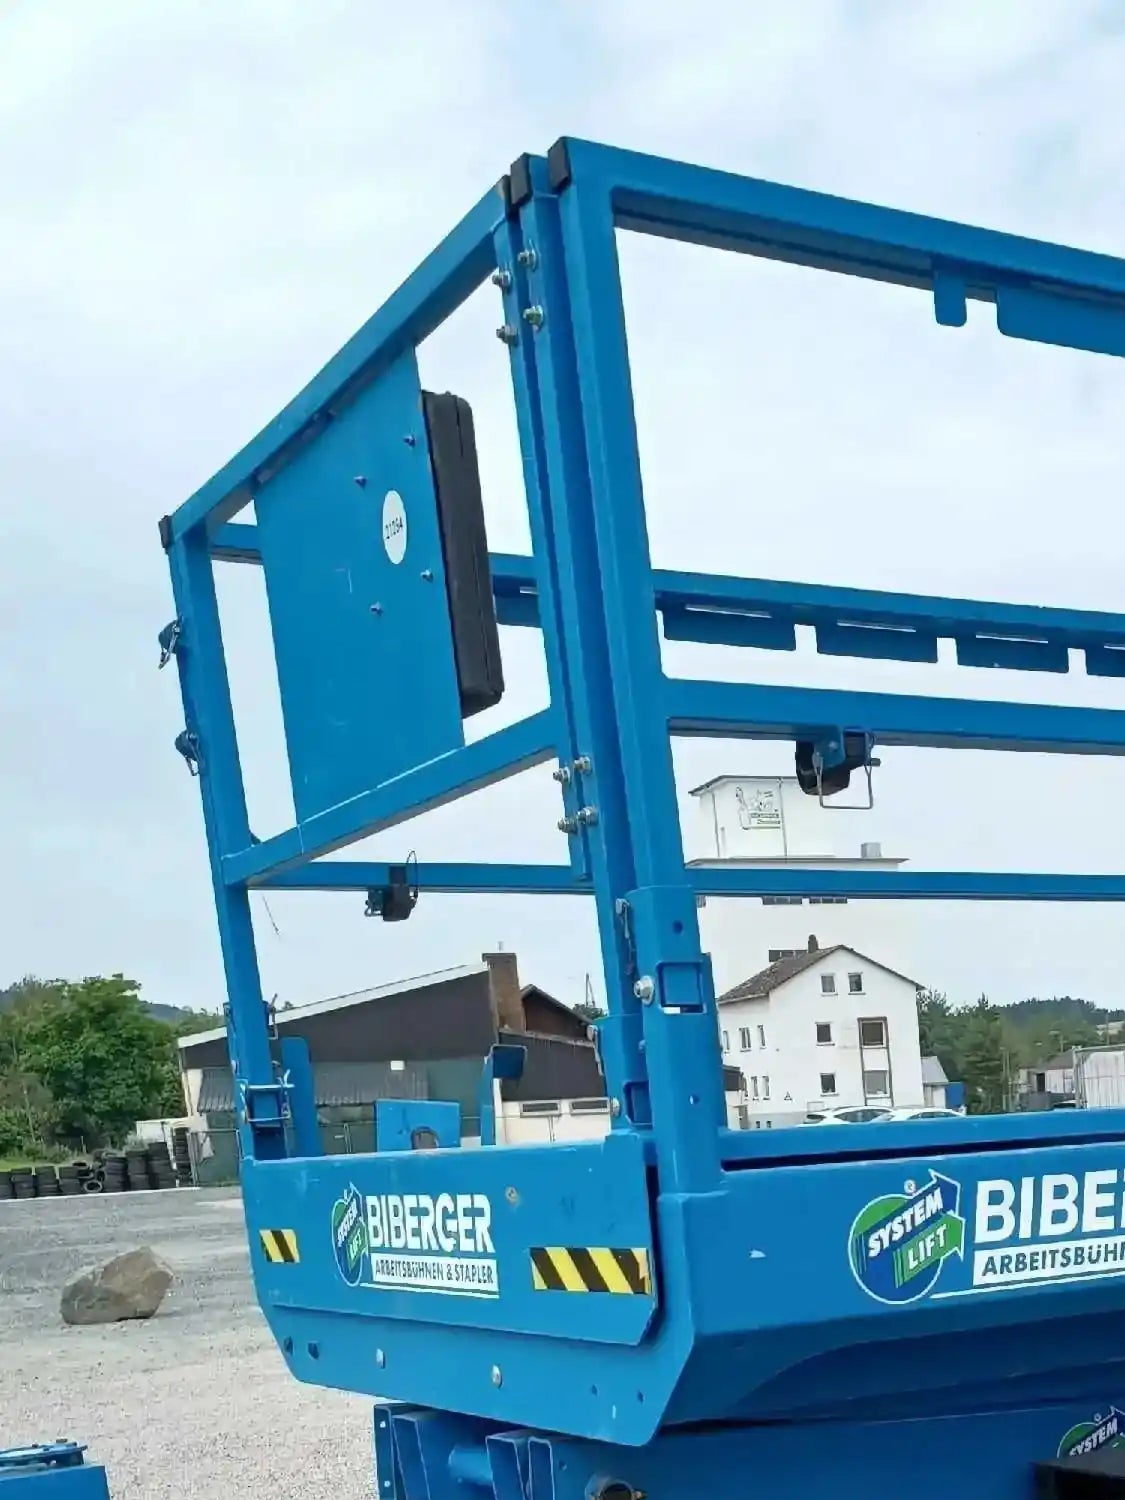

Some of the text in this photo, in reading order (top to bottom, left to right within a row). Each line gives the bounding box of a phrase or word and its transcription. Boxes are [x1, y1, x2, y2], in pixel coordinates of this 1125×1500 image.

[365, 1192, 496, 1254] BIBERGER
[868, 1187, 944, 1258] SYSTEM
[907, 1223, 947, 1270] LIFT
[375, 1258, 444, 1281] ARBEITSBÜHNEN
[454, 1263, 494, 1285] STAPLER
